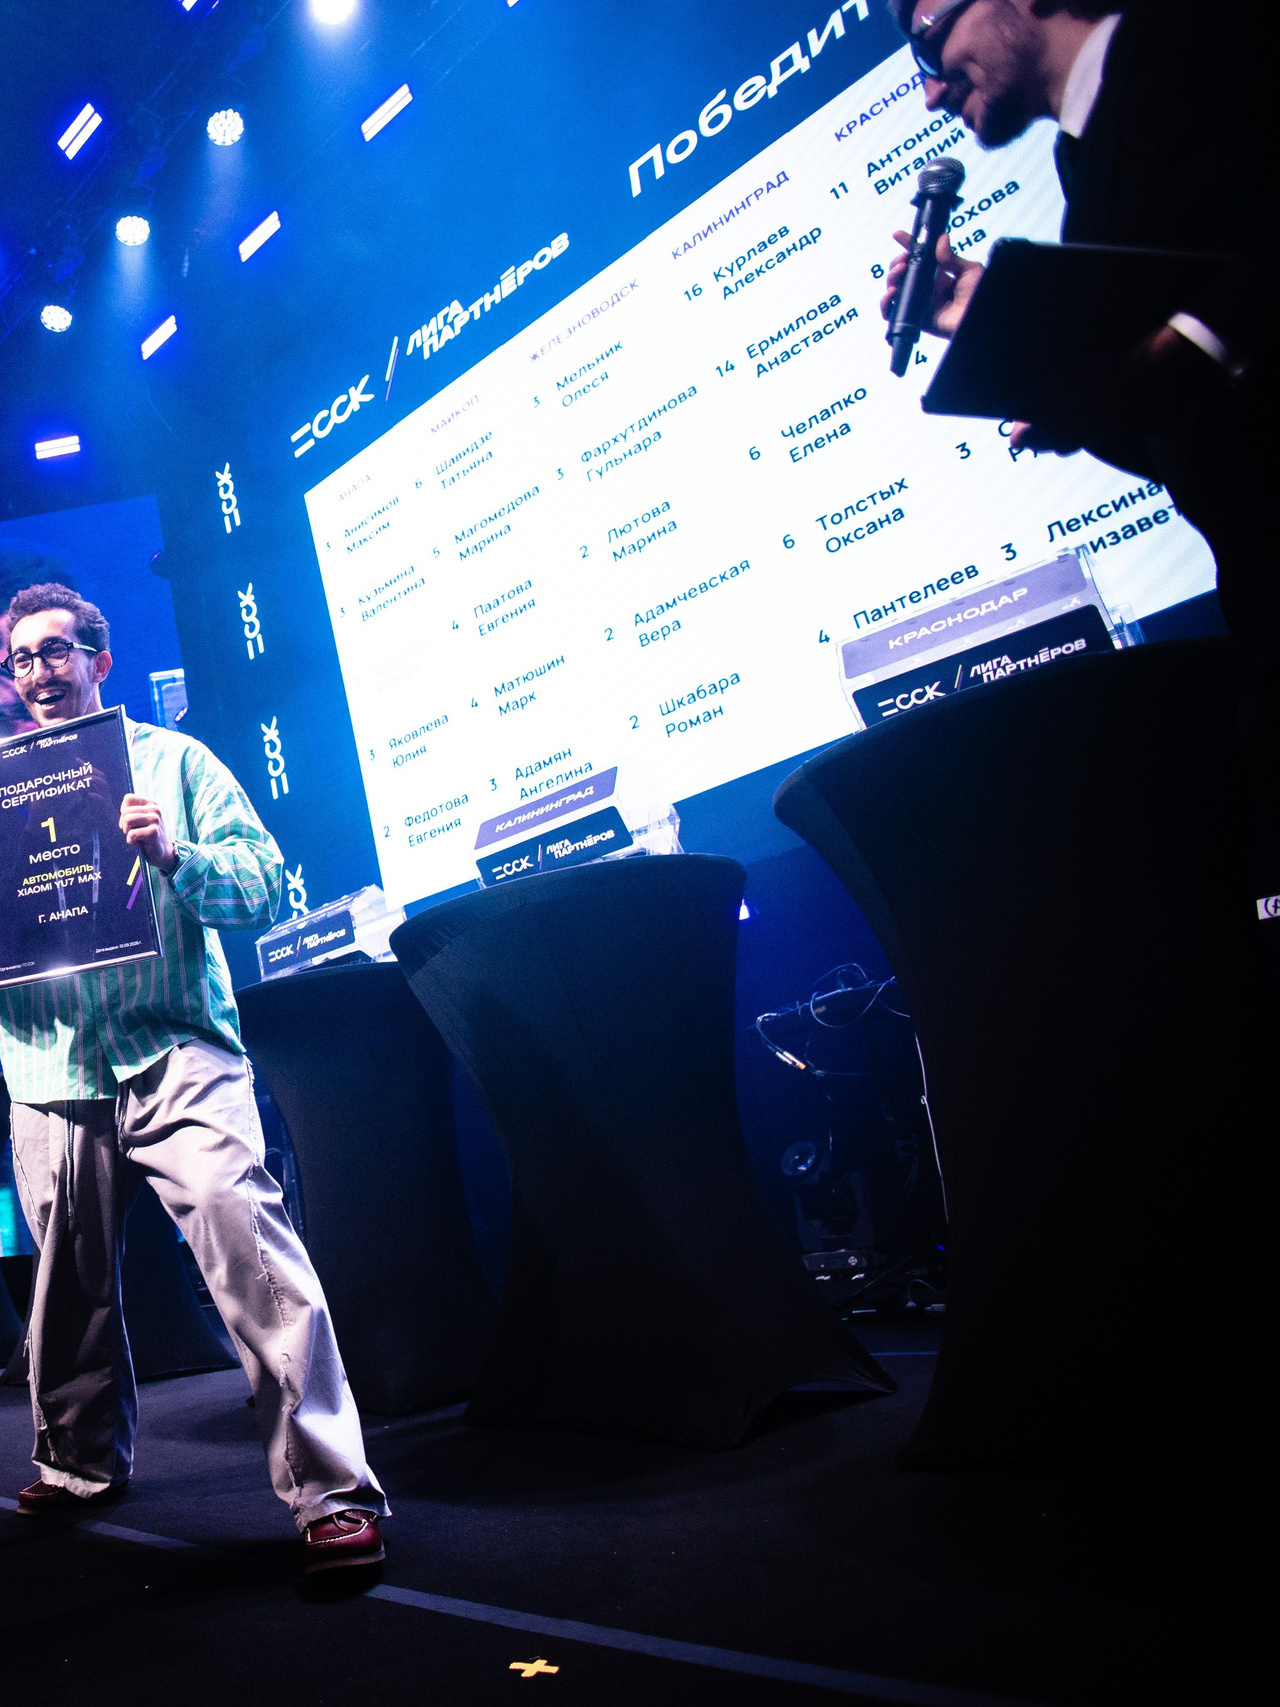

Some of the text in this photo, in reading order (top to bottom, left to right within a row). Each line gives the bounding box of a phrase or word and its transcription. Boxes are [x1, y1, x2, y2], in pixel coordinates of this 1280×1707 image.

[830, 111, 957, 200] 11 Антонов
[873, 126, 966, 195] Виталий
[671, 170, 790, 260] КАЛИНИНГРАД
[683, 225, 790, 301] 16 Курлаев
[723, 227, 822, 300] Александр
[870, 263, 885, 279] 8
[423, 232, 569, 360] ПАРТНЁРОВ
[406, 299, 464, 356] ЛИГА
[529, 278, 640, 363] ЖЕЛЕЗНОВОДСК
[715, 293, 842, 378] 14 Ермилова
[756, 307, 859, 378] Анастасия
[533, 340, 623, 408] 3 Мельник
[915, 350, 928, 365] 4
[561, 370, 609, 408] Олеся
[555, 384, 698, 480] 3 Фархутдинова
[748, 387, 867, 461] 6 Челапко
[789, 422, 852, 463] Елена
[414, 430, 493, 489] 6 Шавидзе
[439, 450, 494, 490] Татьяна
[585, 429, 663, 482] Гульнара
[955, 442, 971, 459] 3
[343, 496, 399, 539] Анисимов
[432, 485, 541, 558] 5 Магомедова
[579, 499, 671, 559] 2 Лютова
[782, 477, 909, 549] 6 Толстых
[825, 507, 905, 553] Оксана
[1000, 481, 1164, 561] 3 Лексина
[346, 521, 391, 555] Максим
[458, 523, 512, 561] Марина
[612, 519, 678, 562] Марина
[339, 565, 415, 617] 3 Кузьмина
[360, 576, 426, 622] Валентина
[451, 578, 533, 631] 4 Паатова
[604, 559, 751, 642] 2 Адамчевская
[818, 564, 979, 643] 4 Пантелеев
[478, 598, 537, 637] Евгения
[639, 618, 682, 648] Вера
[888, 587, 1028, 650] КРАСНОДАР
[470, 654, 566, 708] 4 Матюшин
[969, 655, 1012, 678] ЛИГА
[982, 637, 1087, 683] ПАРТНЁРОВ
[498, 691, 537, 718] Марк
[628, 670, 741, 730] 2 Шкабара
[665, 704, 724, 739] Роман
[368, 713, 449, 761] 3 Яковлева
[392, 744, 428, 770] Юлия
[489, 747, 572, 791] 3 Адамян
[520, 761, 593, 800] Ангелина
[1, 777, 93, 809] СЕРТИФИКАТ
[383, 791, 469, 838] 2 Федотова
[494, 785, 595, 833] КАЛИНИНГРАД
[40, 816, 57, 843] 1
[408, 816, 462, 847] Евгения
[546, 838, 571, 855] ЛИГА
[553, 829, 615, 860] ПАРТНЁРОВ
[17, 871, 102, 897] XIAOMI YU7 MAX
[22, 864, 94, 886] АВТОМОБИЛЬ
[38, 905, 89, 923] Г. АНАПА
